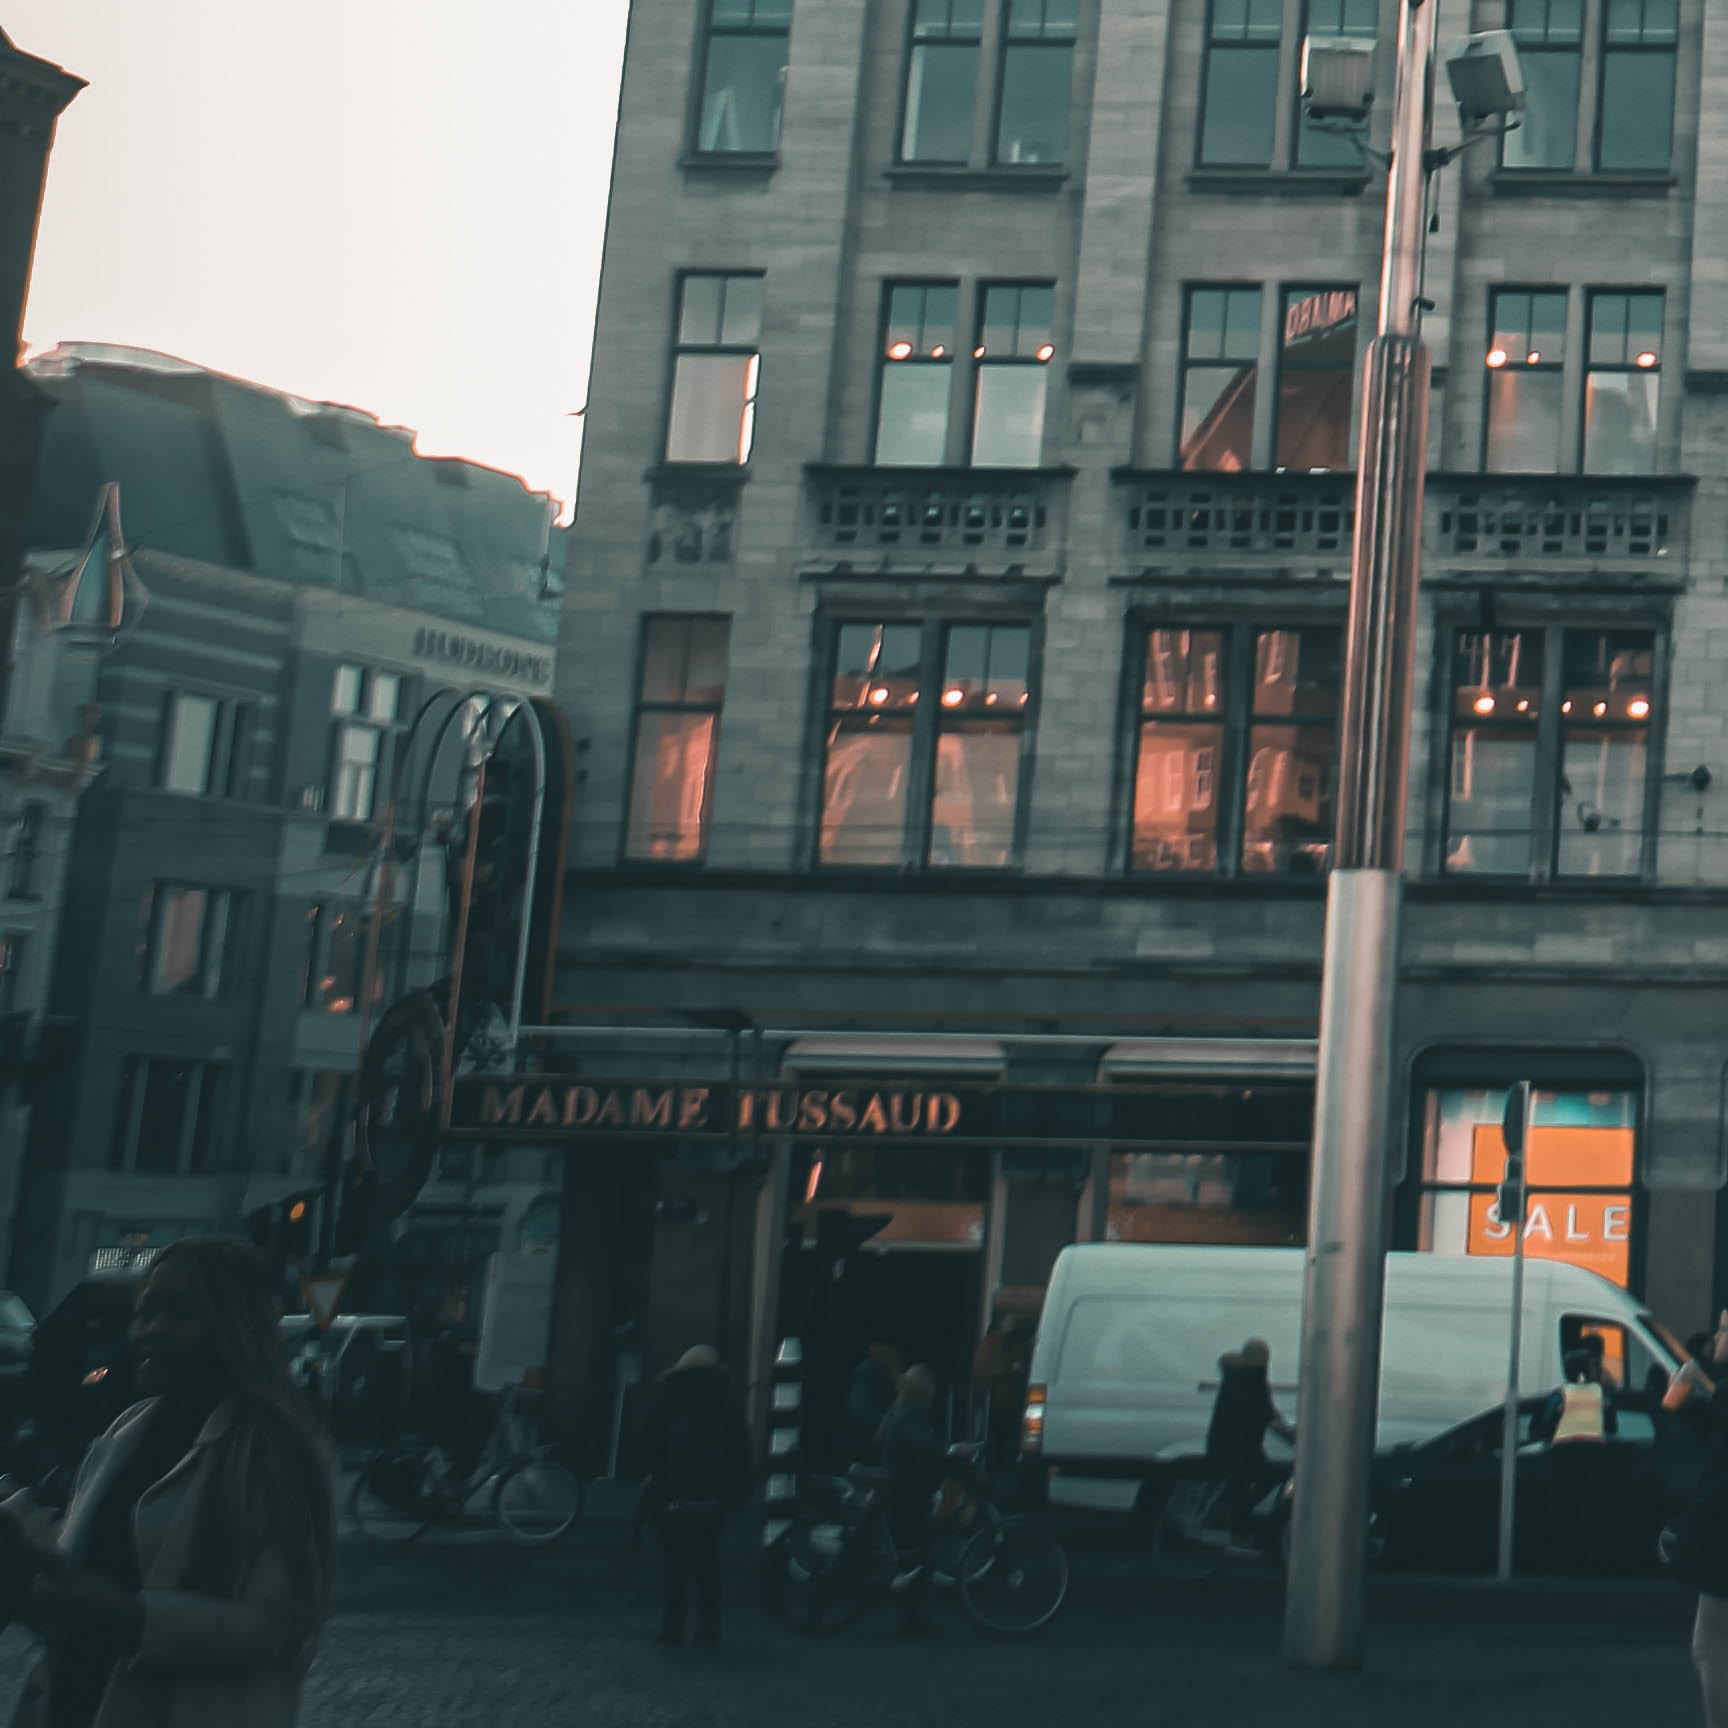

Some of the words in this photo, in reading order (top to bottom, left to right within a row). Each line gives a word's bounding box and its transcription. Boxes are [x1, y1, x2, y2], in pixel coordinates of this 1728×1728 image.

[480, 1084, 710, 1130] MADAME
[736, 1087, 961, 1135] TUSSAUD
[1484, 1204, 1629, 1242] SALE
